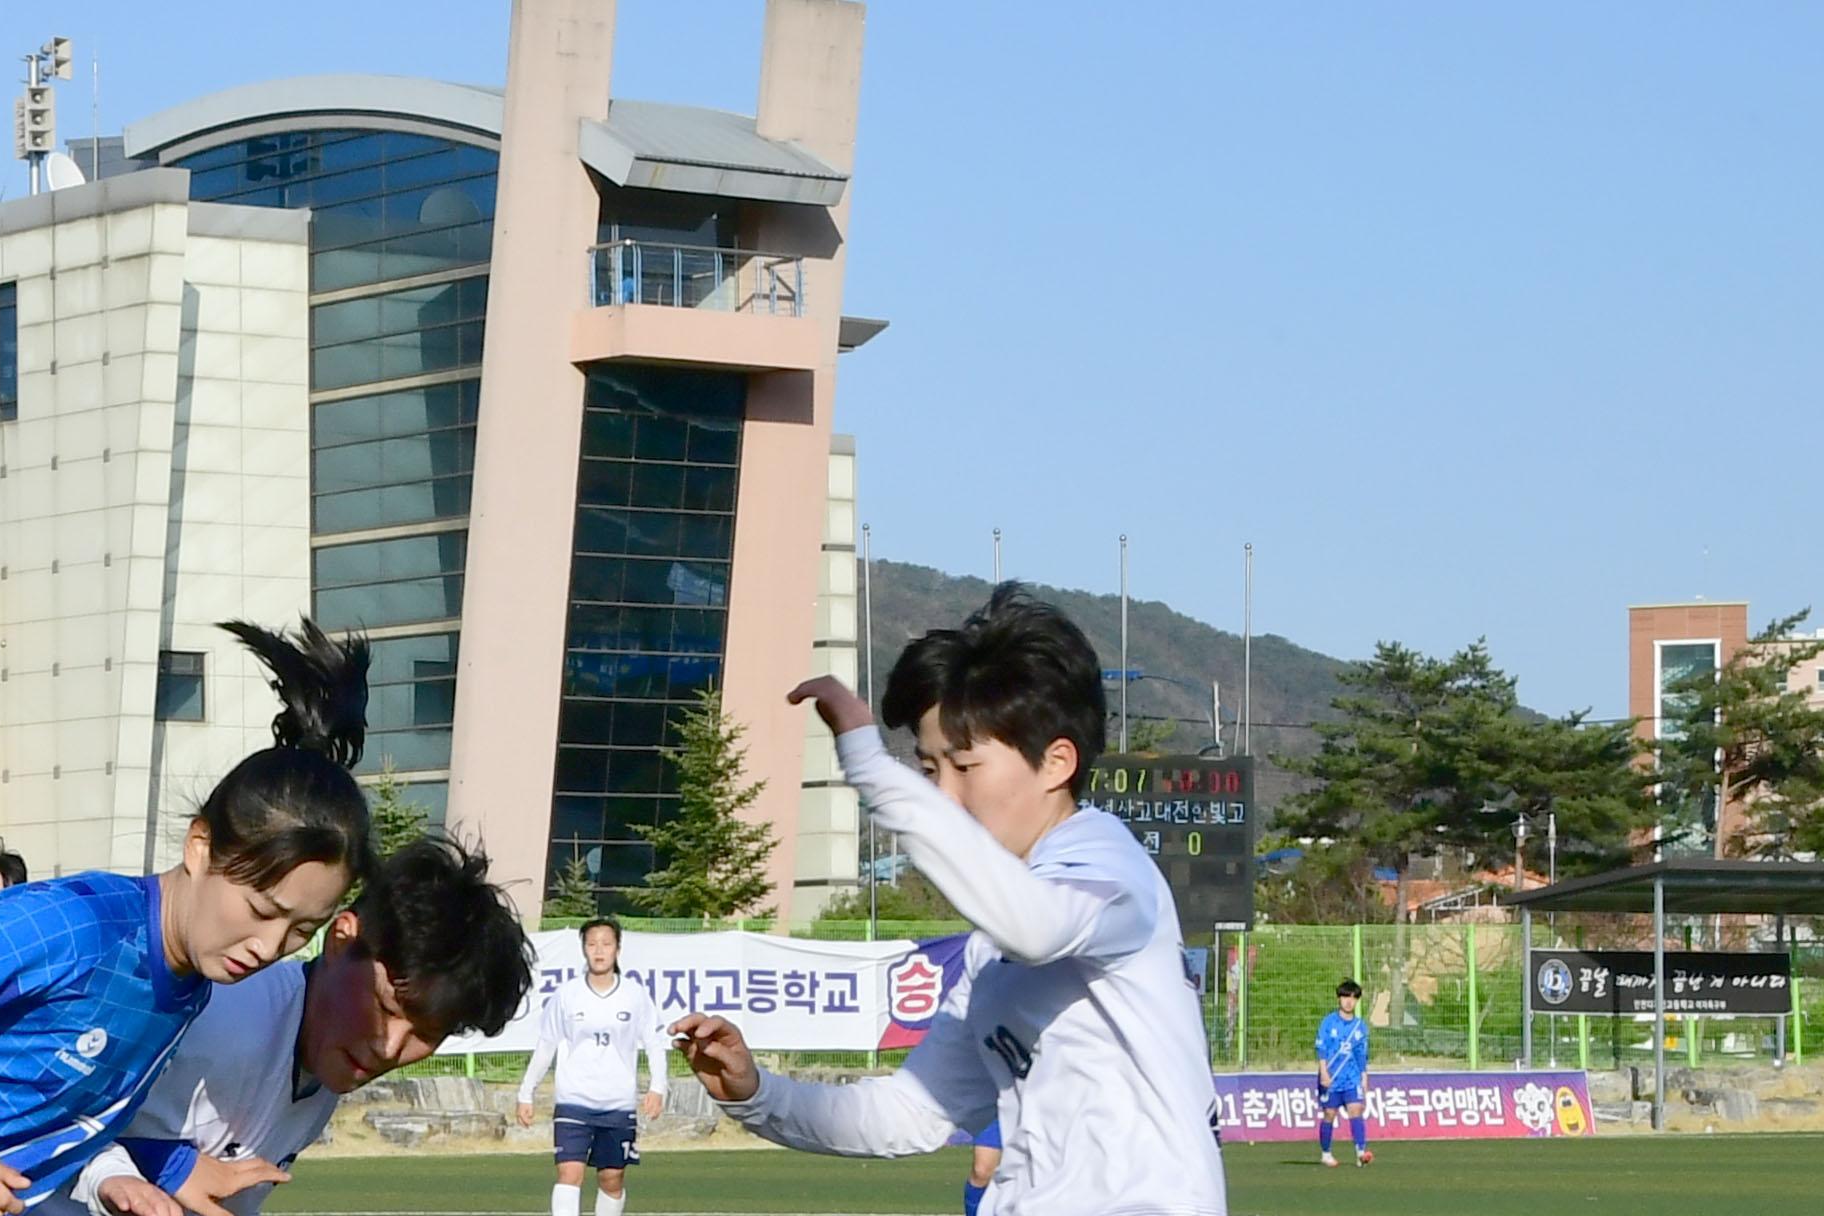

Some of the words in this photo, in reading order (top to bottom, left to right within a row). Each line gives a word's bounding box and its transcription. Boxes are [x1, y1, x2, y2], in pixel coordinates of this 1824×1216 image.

[1189, 832, 1201, 855] 0
[897, 961, 936, 1013] 승
[594, 1032, 610, 1047] 13
[1243, 1086, 1505, 1129] 춘계한자축구연맹전
